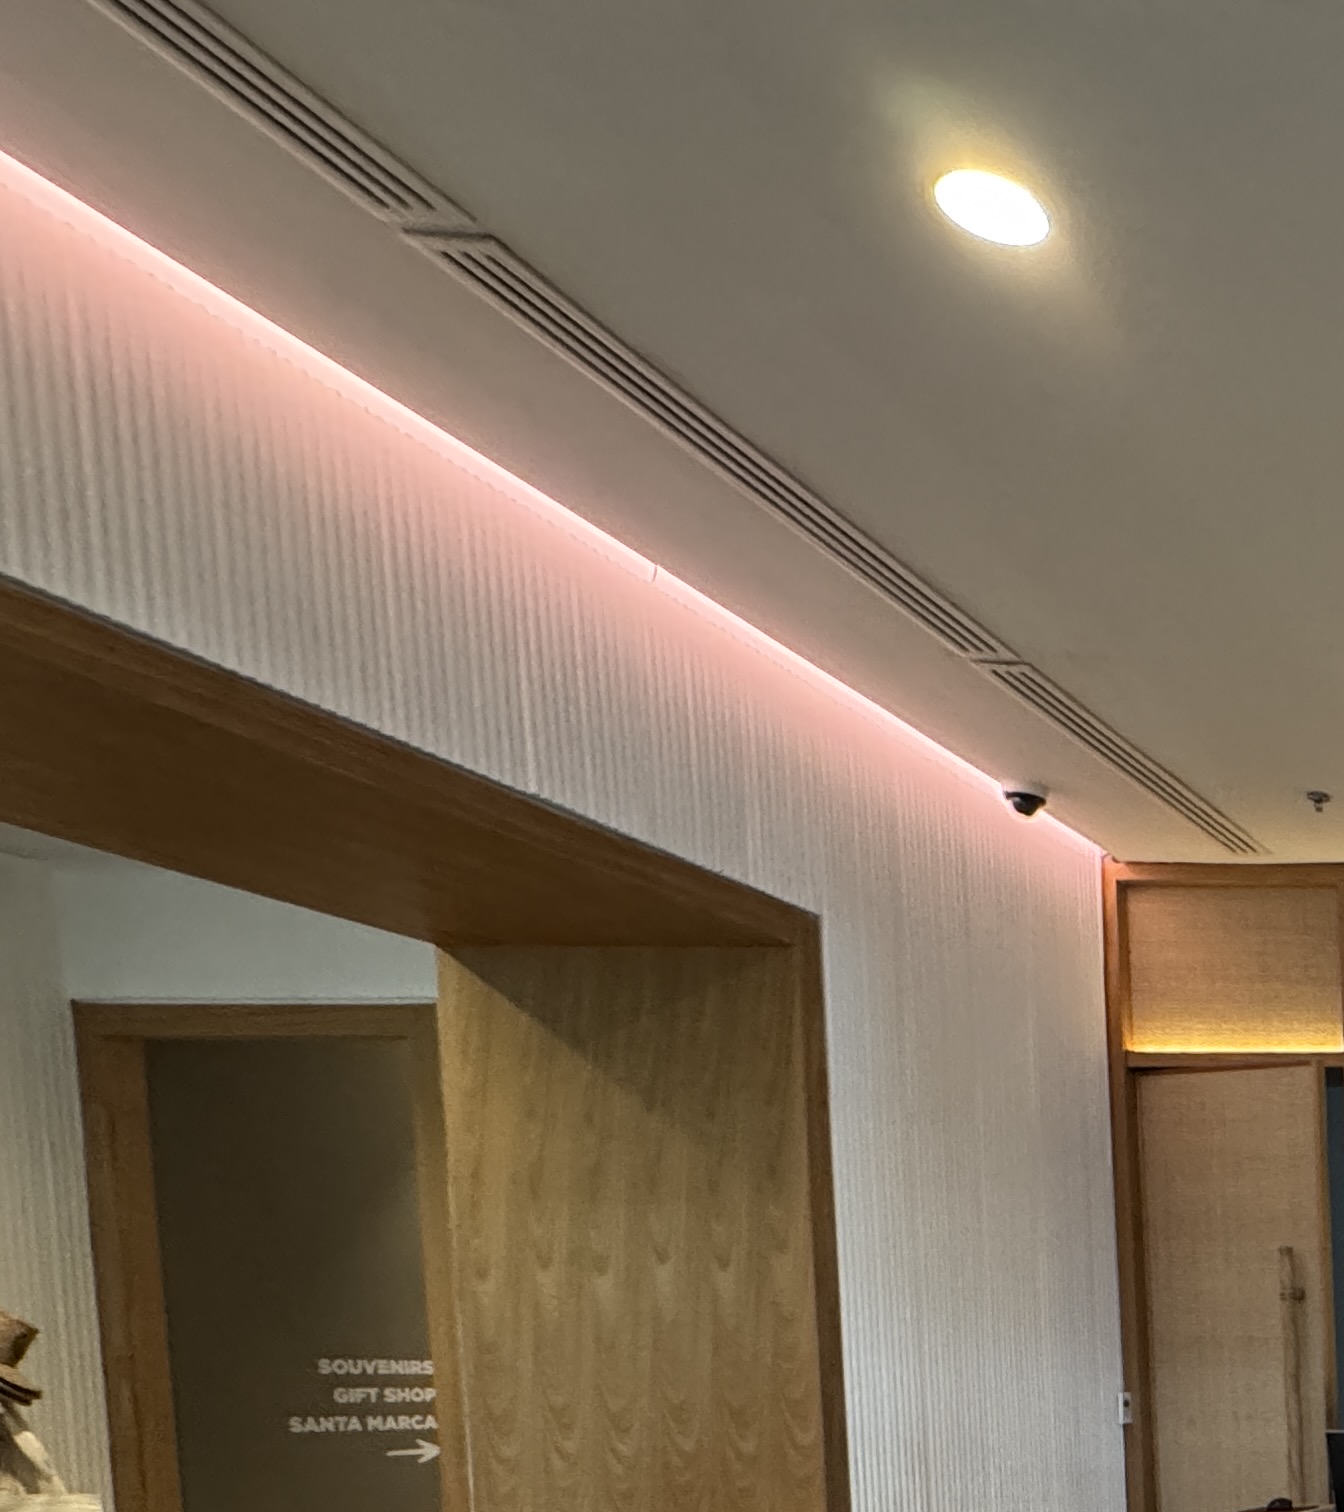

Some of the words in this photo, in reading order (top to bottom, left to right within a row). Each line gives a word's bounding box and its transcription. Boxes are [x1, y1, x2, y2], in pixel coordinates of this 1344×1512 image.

[317, 1358, 435, 1375] SOUVENIRS
[333, 1387, 379, 1403] GIFT
[383, 1387, 437, 1402] SHOP
[288, 1416, 363, 1433] SANTA
[366, 1414, 439, 1431] MARCA
